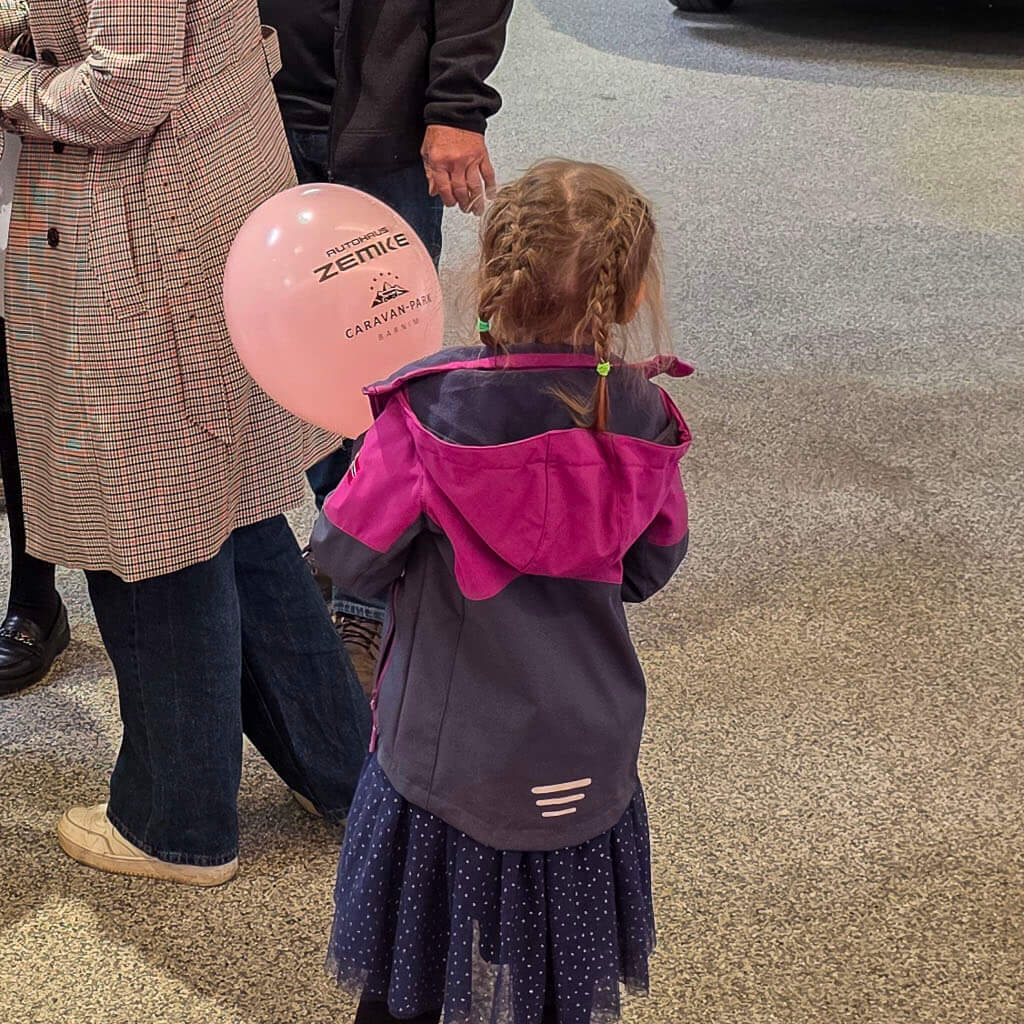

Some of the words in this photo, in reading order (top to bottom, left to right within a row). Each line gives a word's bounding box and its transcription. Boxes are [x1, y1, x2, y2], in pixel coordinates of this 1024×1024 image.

[313, 233, 410, 283] ZEMKE
[326, 226, 390, 257] AUTOHAUS
[345, 294, 433, 339] CARAVAN-PARK
